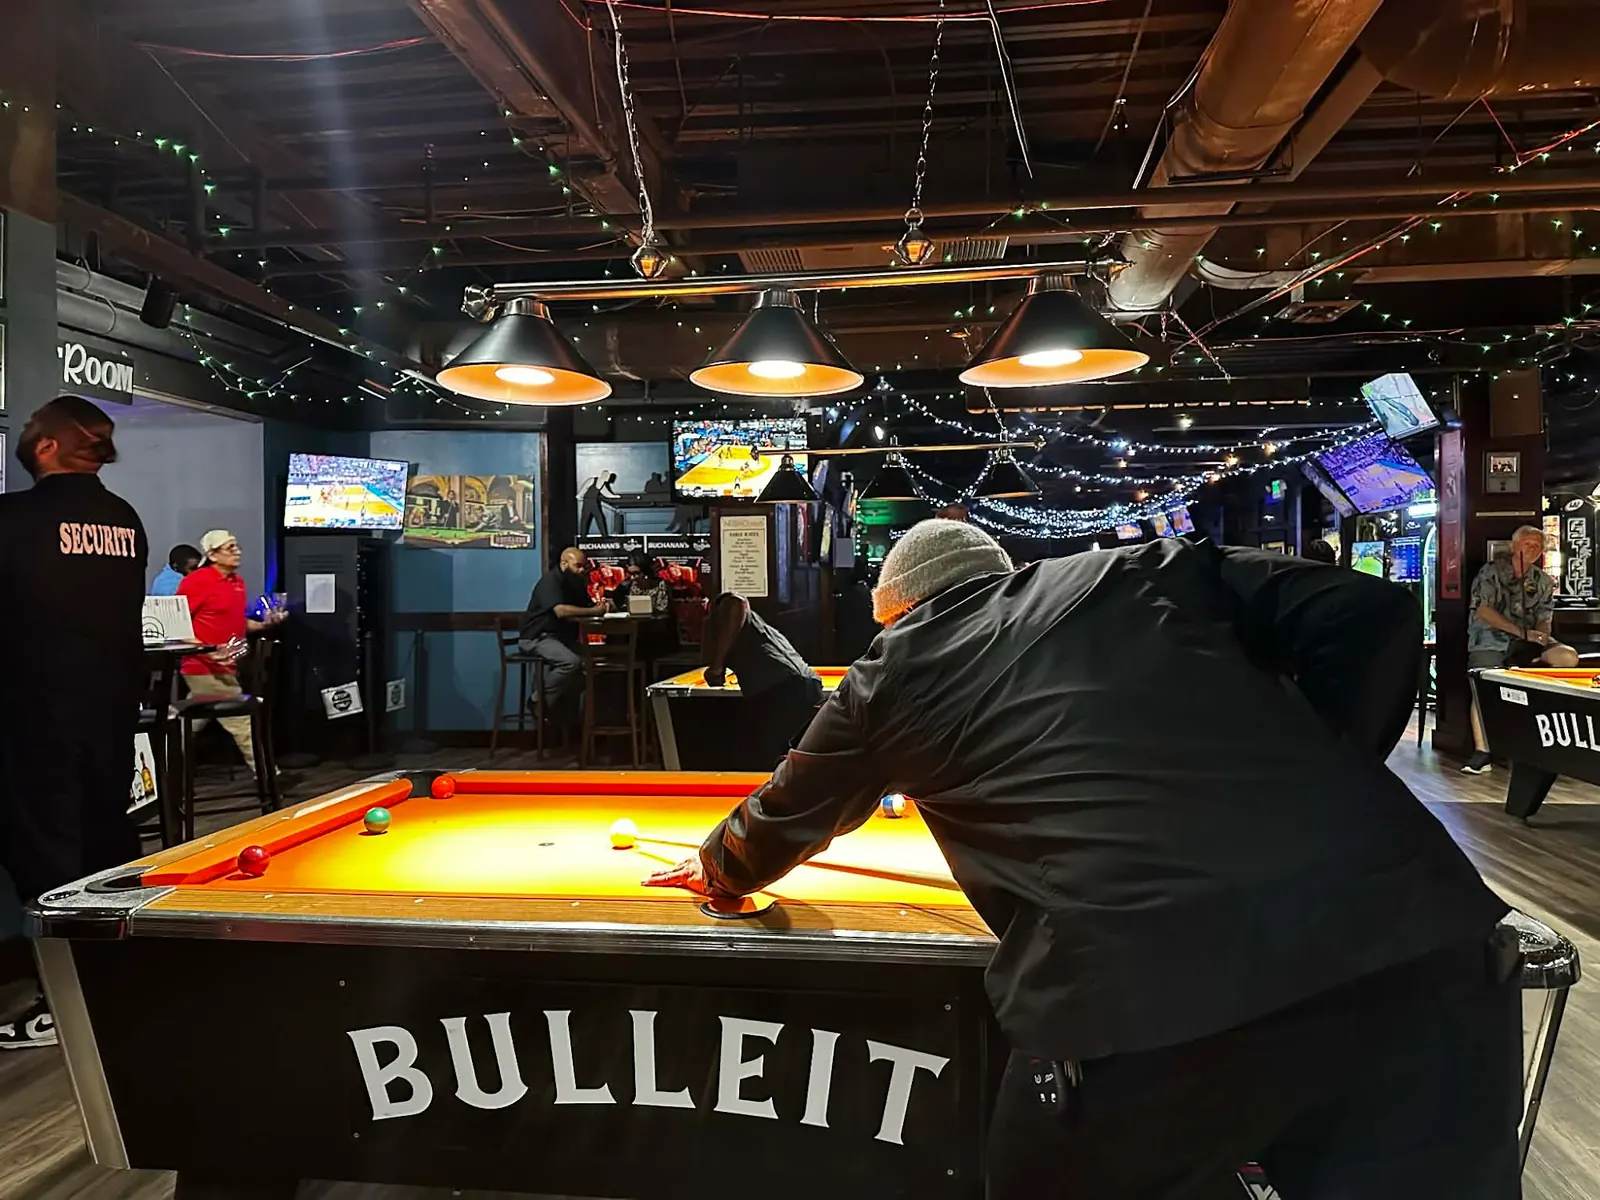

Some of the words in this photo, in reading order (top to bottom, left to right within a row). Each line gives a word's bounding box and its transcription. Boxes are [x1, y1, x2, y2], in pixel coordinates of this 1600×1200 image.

[59, 522, 136, 558] SECURITY
[579, 542, 620, 550] BUCHANAN'S
[346, 1009, 950, 1145] BULLEIT
